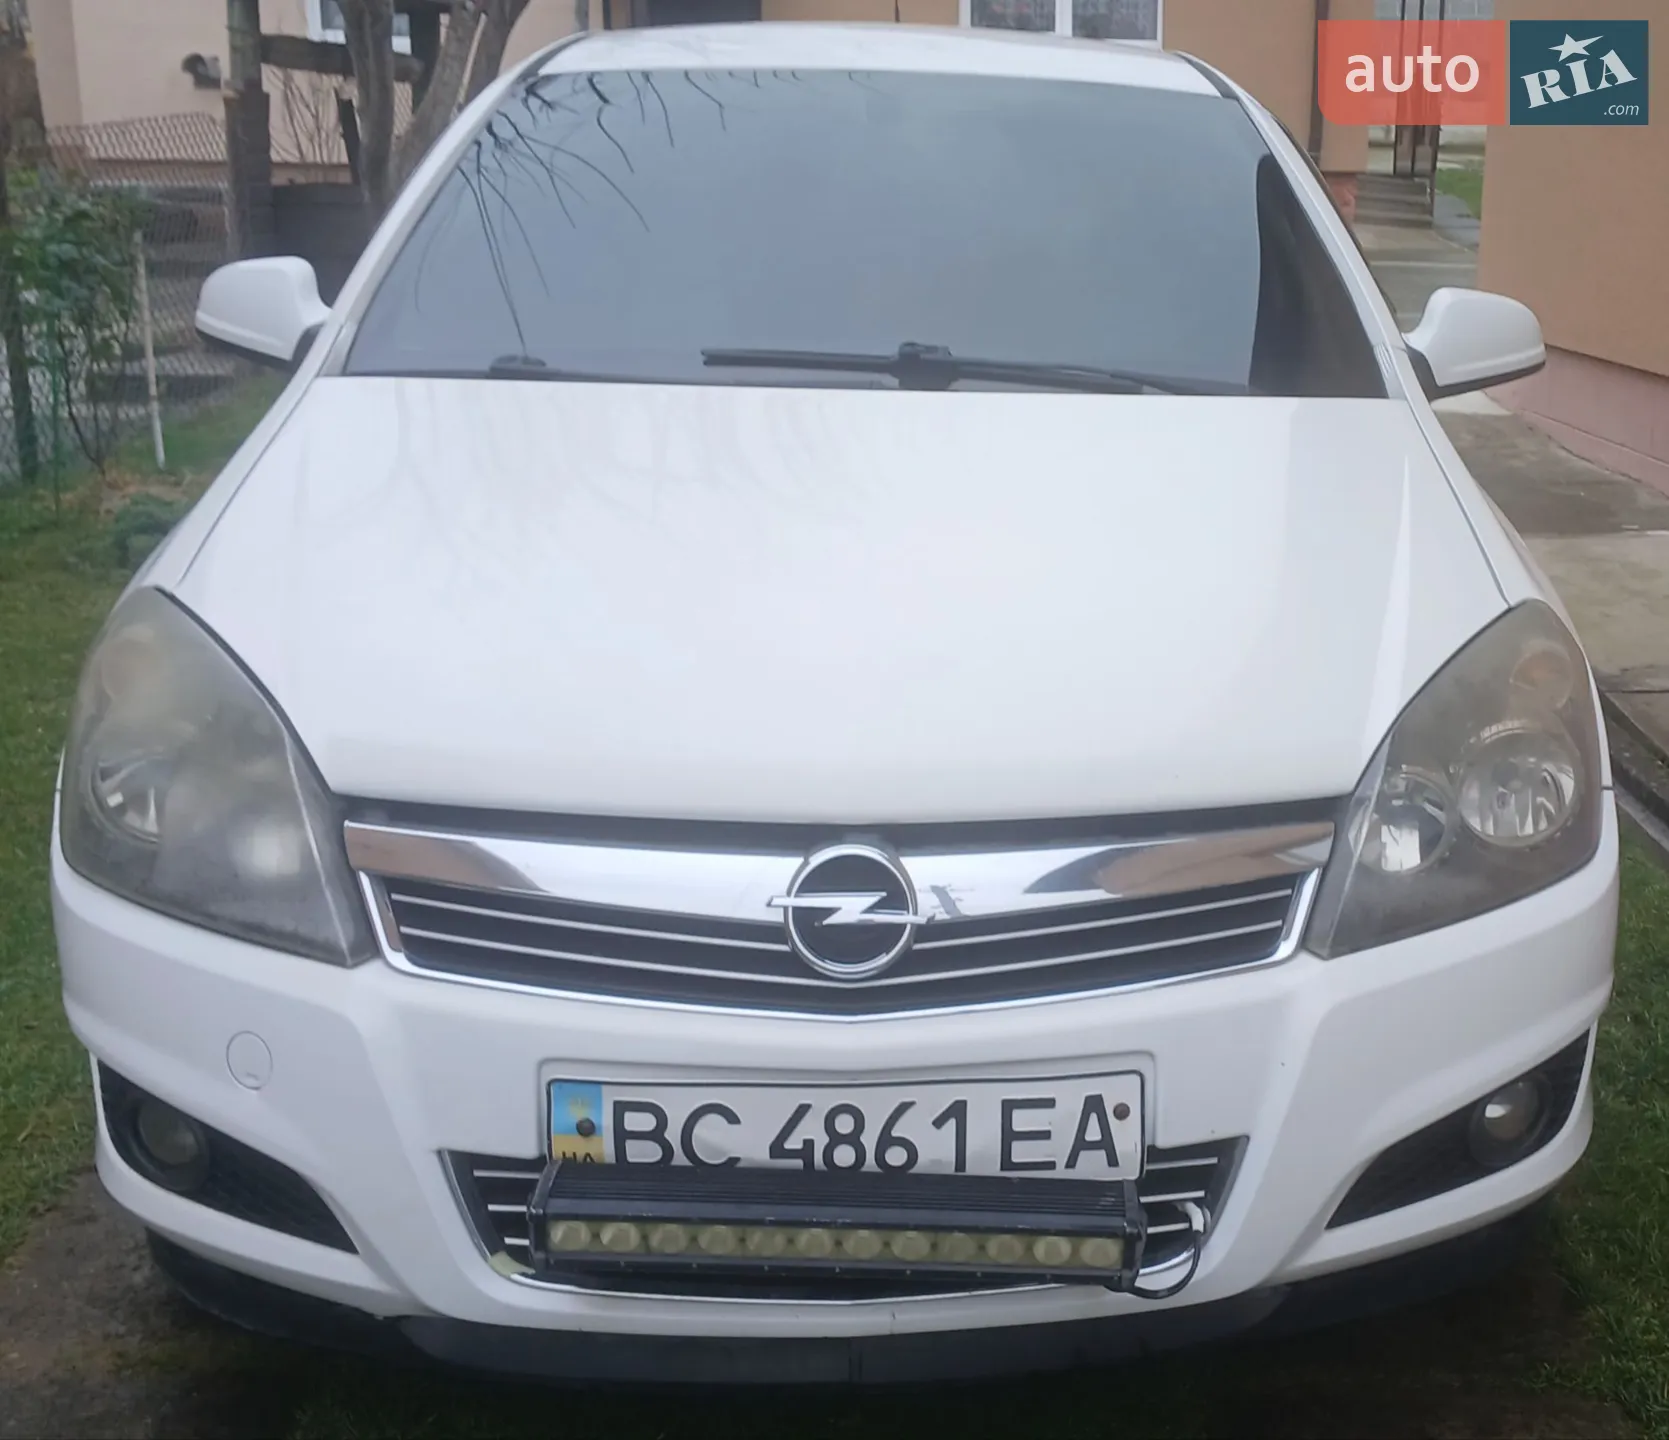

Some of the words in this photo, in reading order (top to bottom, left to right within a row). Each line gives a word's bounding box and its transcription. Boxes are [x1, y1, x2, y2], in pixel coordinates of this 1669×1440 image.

[612, 1099, 742, 1171] BC
[768, 1100, 967, 1173] 4861
[1000, 1094, 1121, 1172] EA
